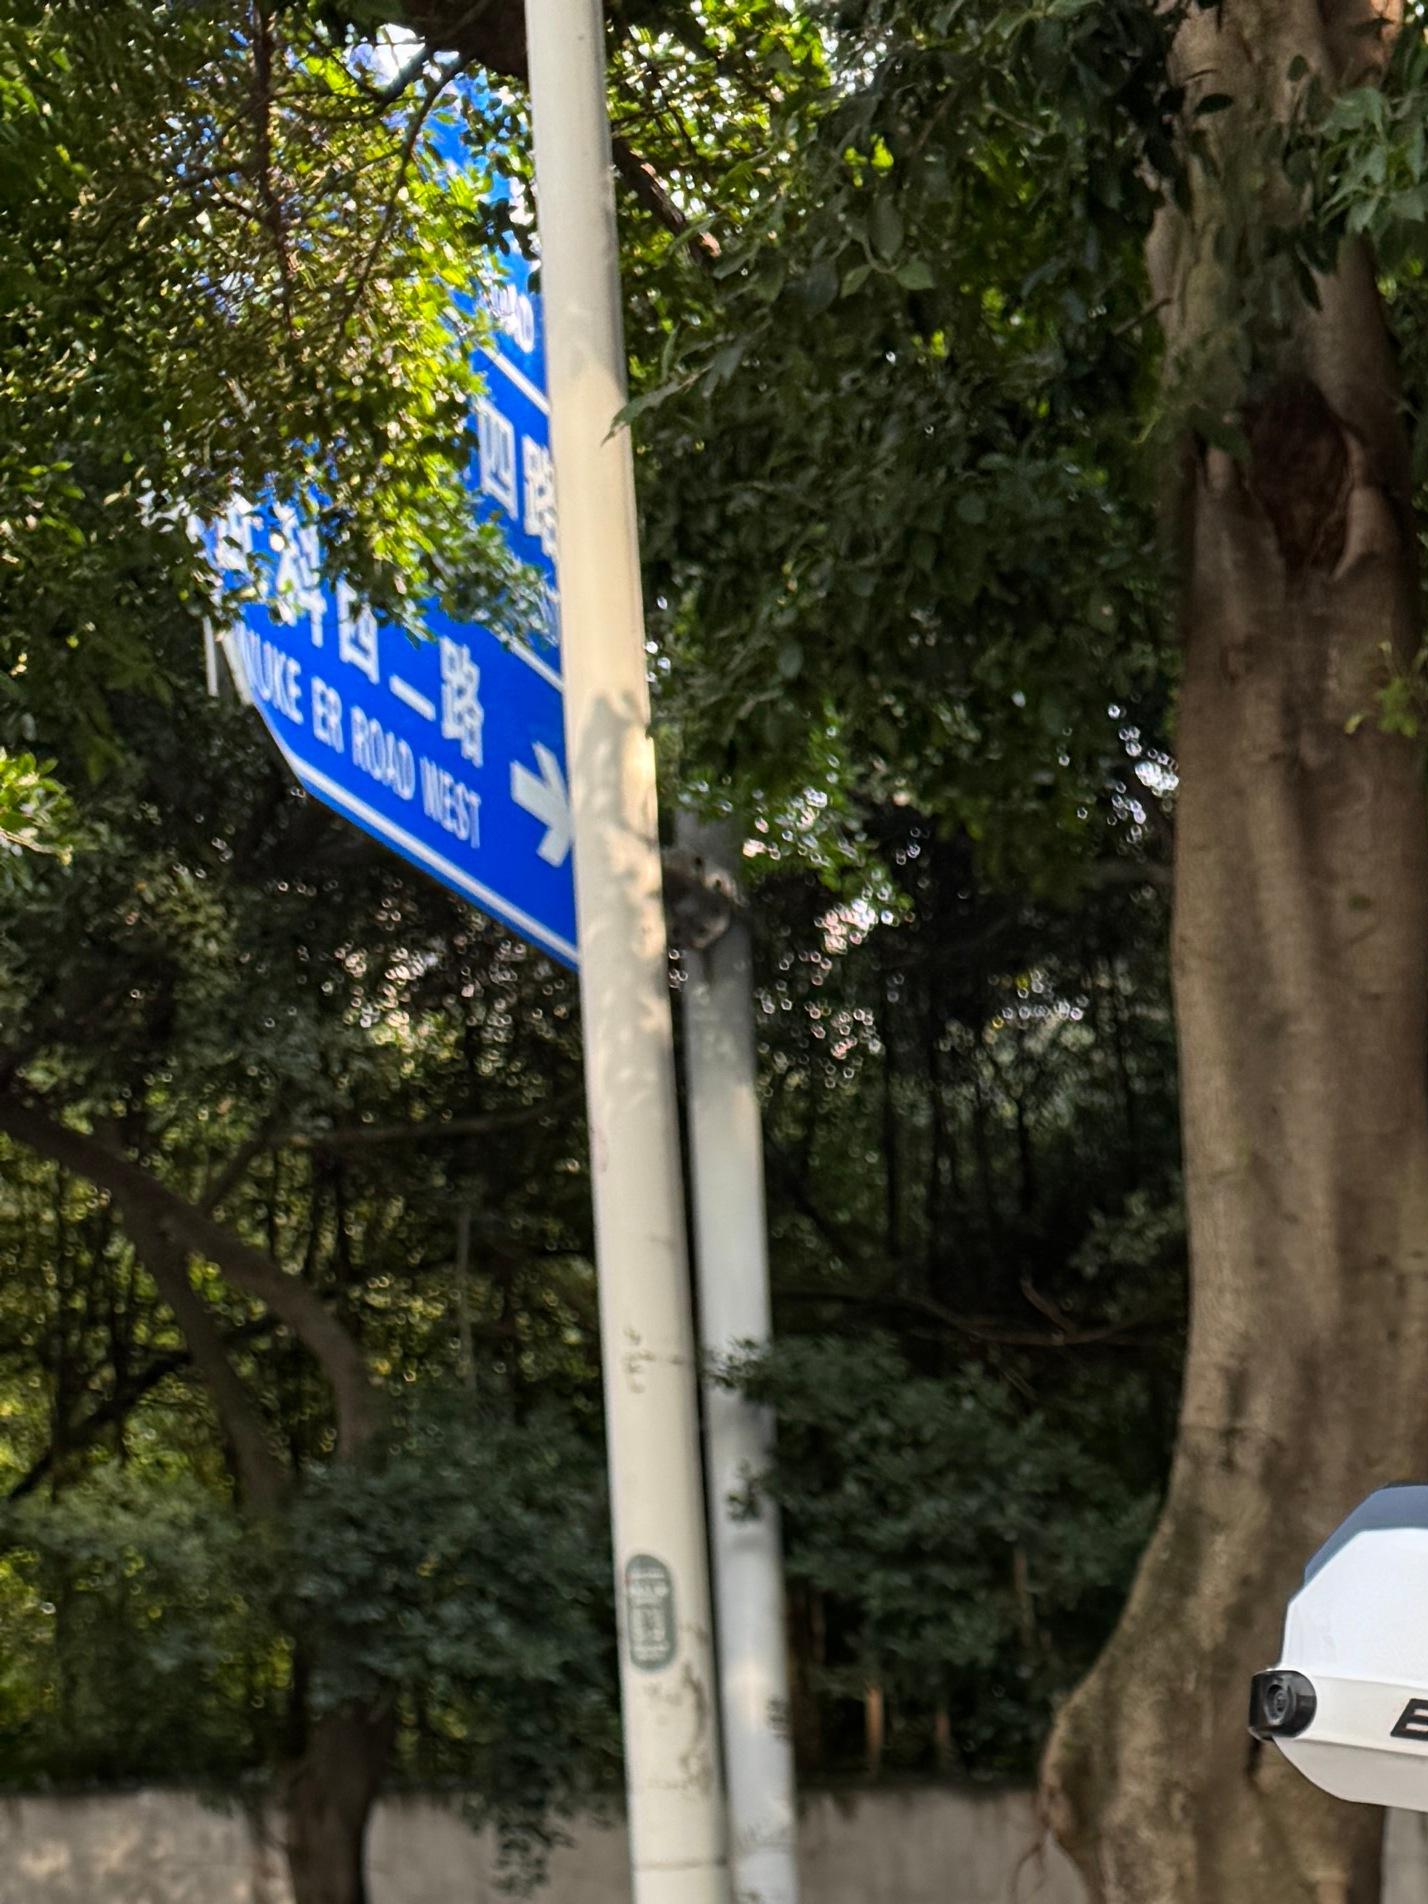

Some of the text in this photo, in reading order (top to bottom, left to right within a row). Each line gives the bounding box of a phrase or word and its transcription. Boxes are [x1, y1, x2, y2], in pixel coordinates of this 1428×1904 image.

[311, 675, 344, 753] ER
[351, 705, 416, 800] ROAD
[420, 756, 481, 848] WEST
